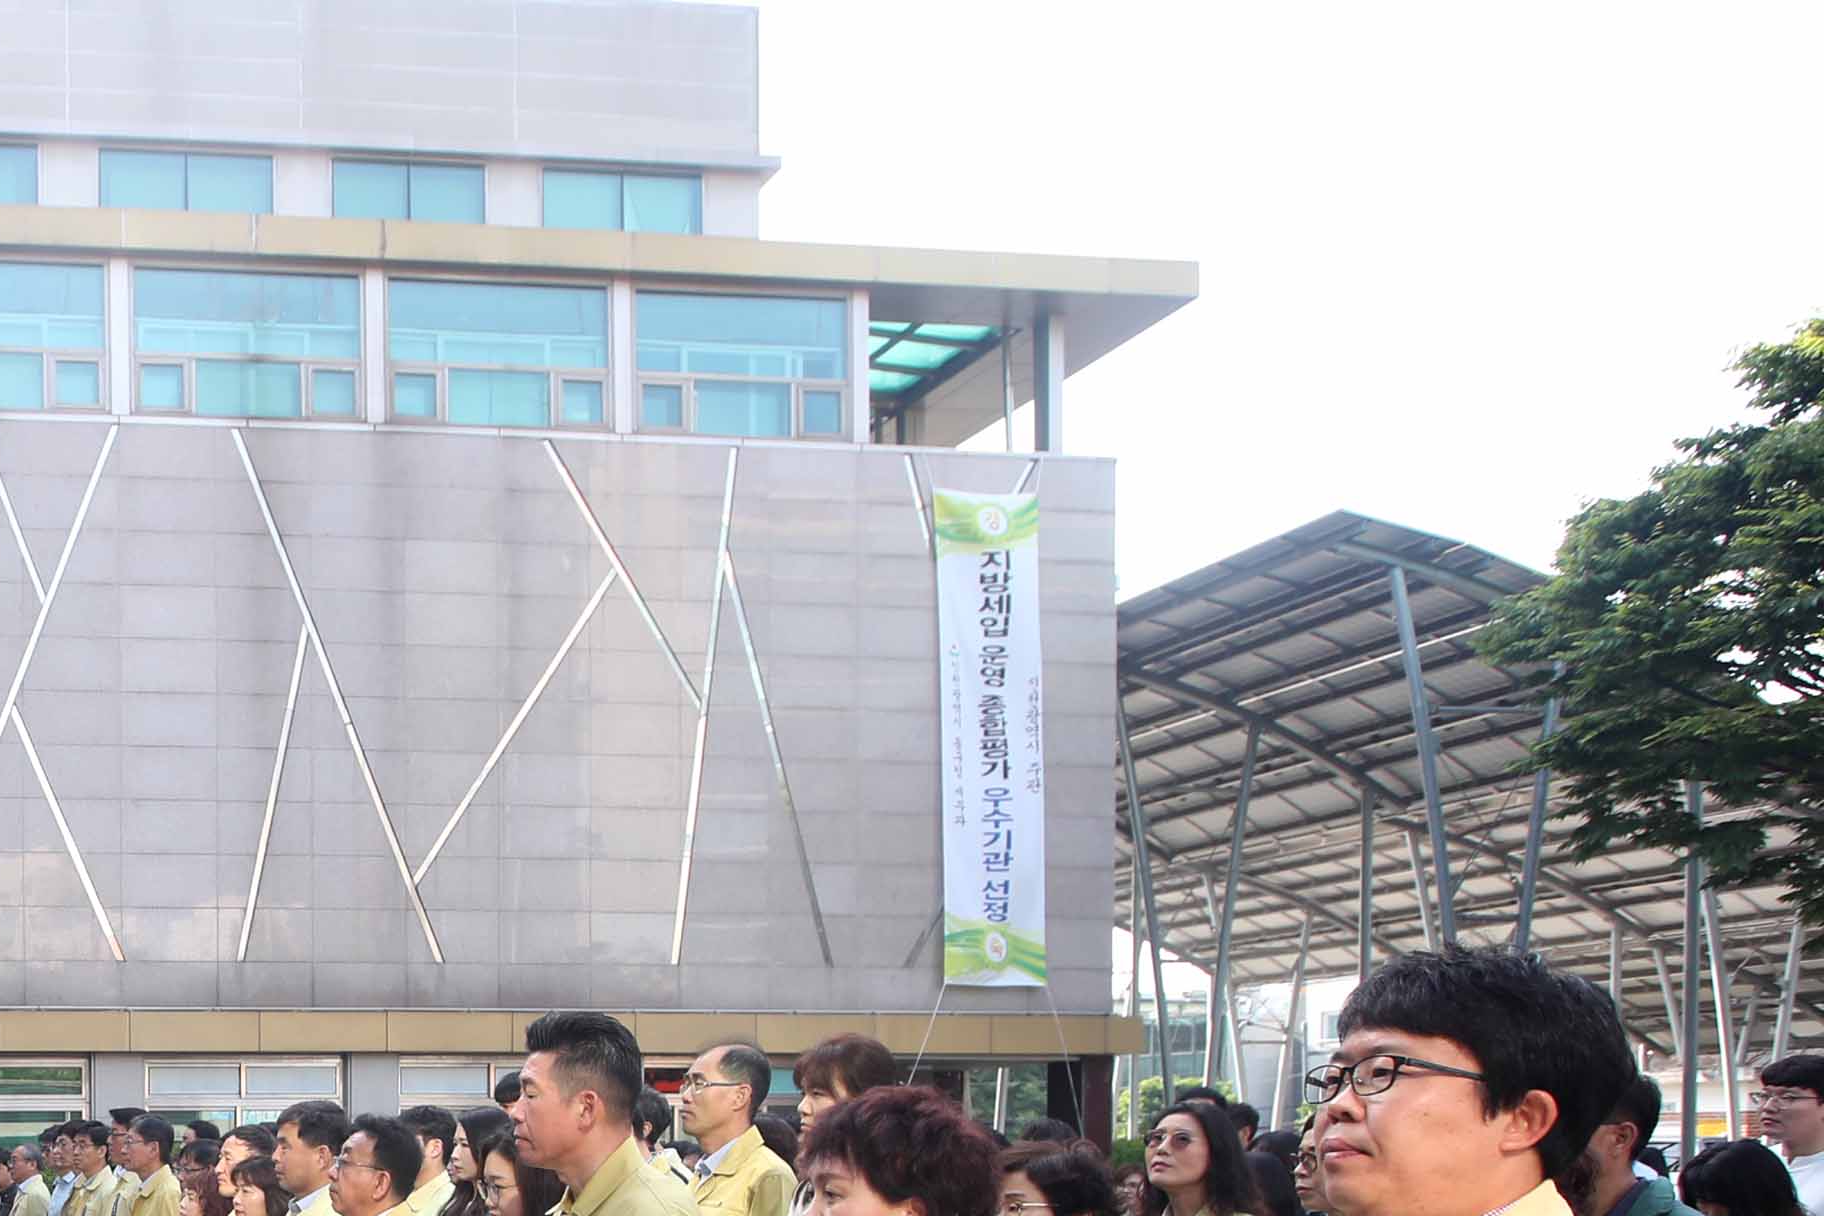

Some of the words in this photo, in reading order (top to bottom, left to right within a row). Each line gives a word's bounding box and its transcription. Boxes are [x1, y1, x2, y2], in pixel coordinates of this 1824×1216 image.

[978, 549, 1012, 638] 지방세입
[978, 644, 1009, 688] 운영
[978, 694, 1011, 780] 종합평가
[981, 786, 1014, 873] 우수기관
[982, 878, 1010, 923] 선정
